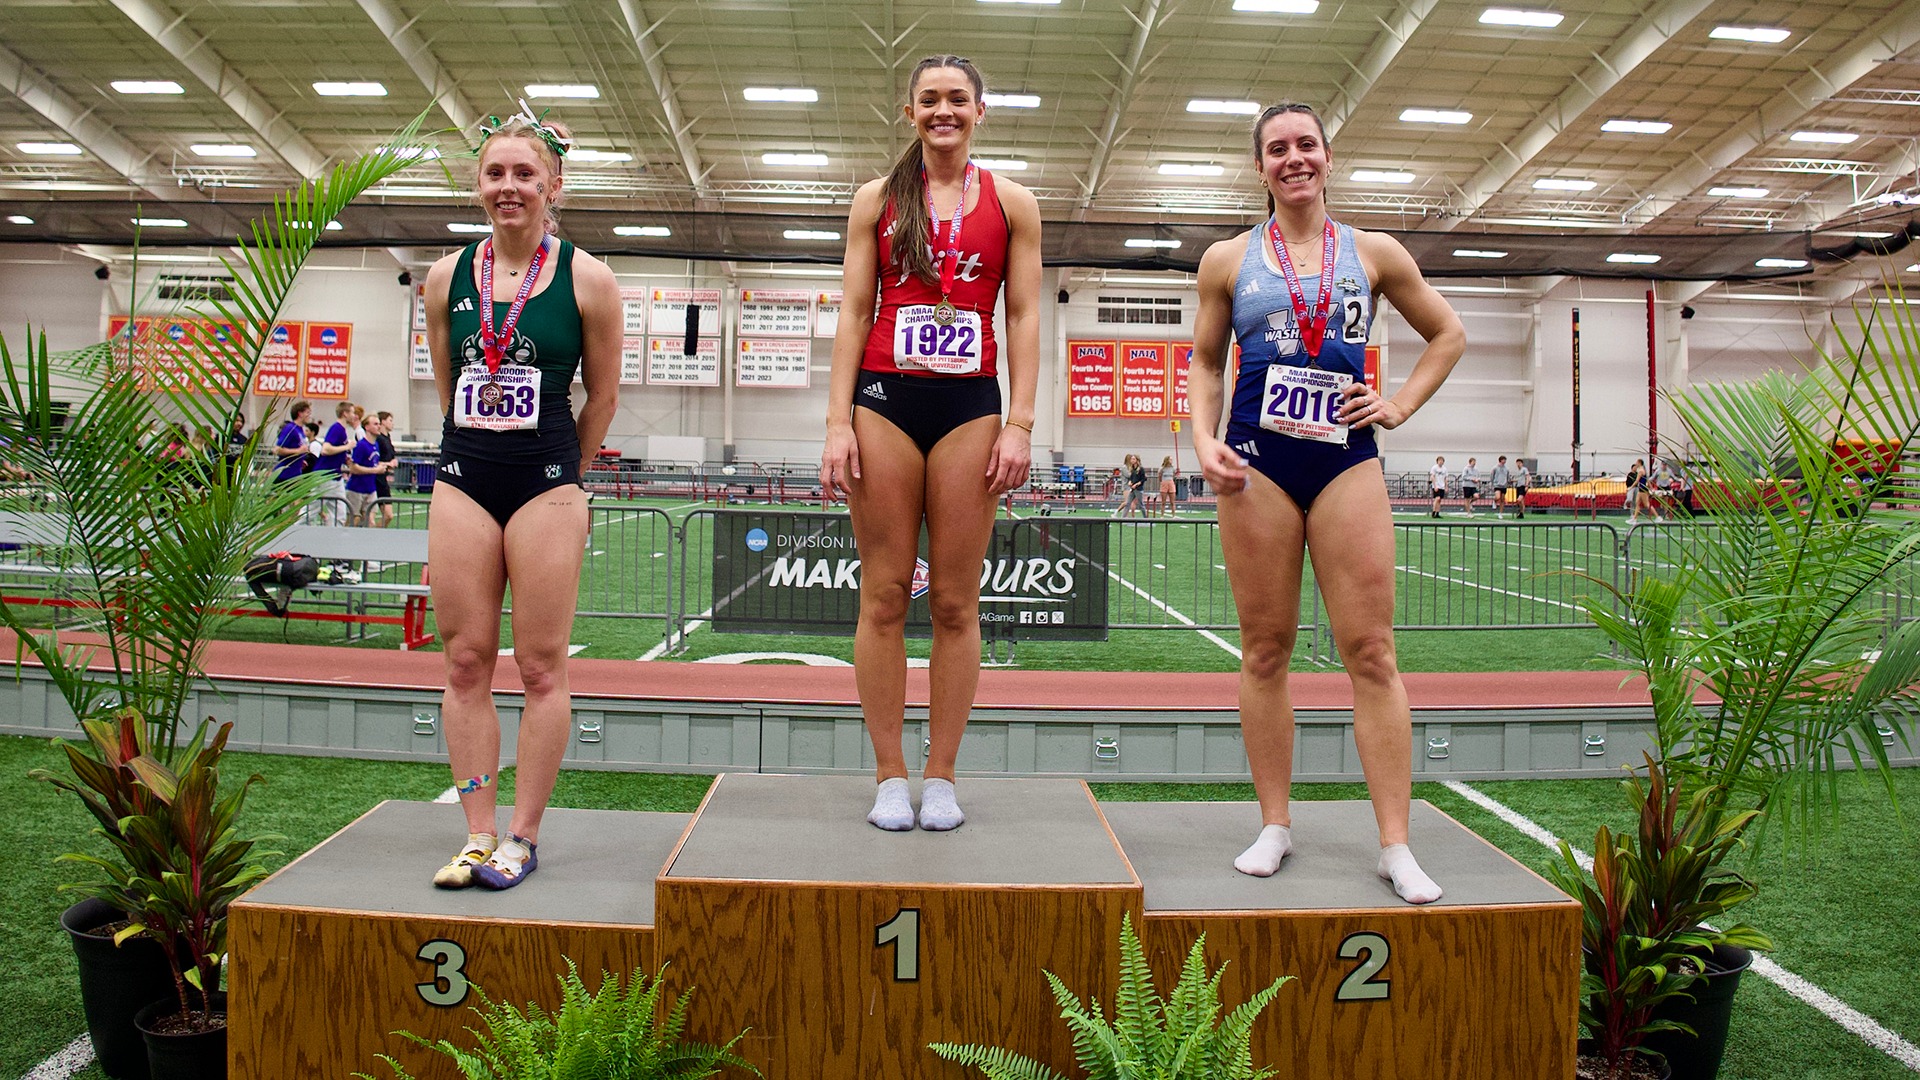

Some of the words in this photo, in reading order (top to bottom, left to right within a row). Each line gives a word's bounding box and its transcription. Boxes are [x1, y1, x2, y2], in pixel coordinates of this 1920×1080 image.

[1345, 301, 1362, 338] 2
[901, 324, 975, 357] 1922
[309, 347, 327, 356] THIRD
[328, 348, 347, 357] PLACE
[1078, 347, 1106, 359] NAIA
[1129, 349, 1158, 362] NAIA
[494, 367, 527, 376] NDOOR
[1071, 364, 1094, 372] Fourth
[1095, 365, 1113, 373] Place
[1123, 367, 1145, 375] Fourth
[1288, 369, 1308, 378] MIAA
[1309, 372, 1335, 381] INDOOR
[259, 374, 295, 392] 2024
[307, 377, 344, 394] 2025
[1090, 384, 1113, 392] Country
[1123, 385, 1141, 393] Track
[1142, 385, 1147, 393] &
[1148, 385, 1164, 393] Field
[1281, 375, 1339, 389] CHAMPIONSHIPS
[862, 387, 888, 401] adidas
[1073, 395, 1111, 411] 1965
[1124, 397, 1162, 412] 1989
[1175, 397, 1190, 412] 19
[1266, 383, 1345, 425] 2016
[1273, 418, 1296, 427] HOSTED
[1305, 422, 1336, 433] PITTSBURG
[1278, 425, 1296, 433] STATE
[1297, 428, 1330, 438] UNIVERSITY
[777, 534, 844, 549] DIVISION
[768, 556, 862, 590] MAK
[875, 907, 920, 981] 1
[415, 937, 470, 1007] 3
[1334, 931, 1391, 1002] 2
